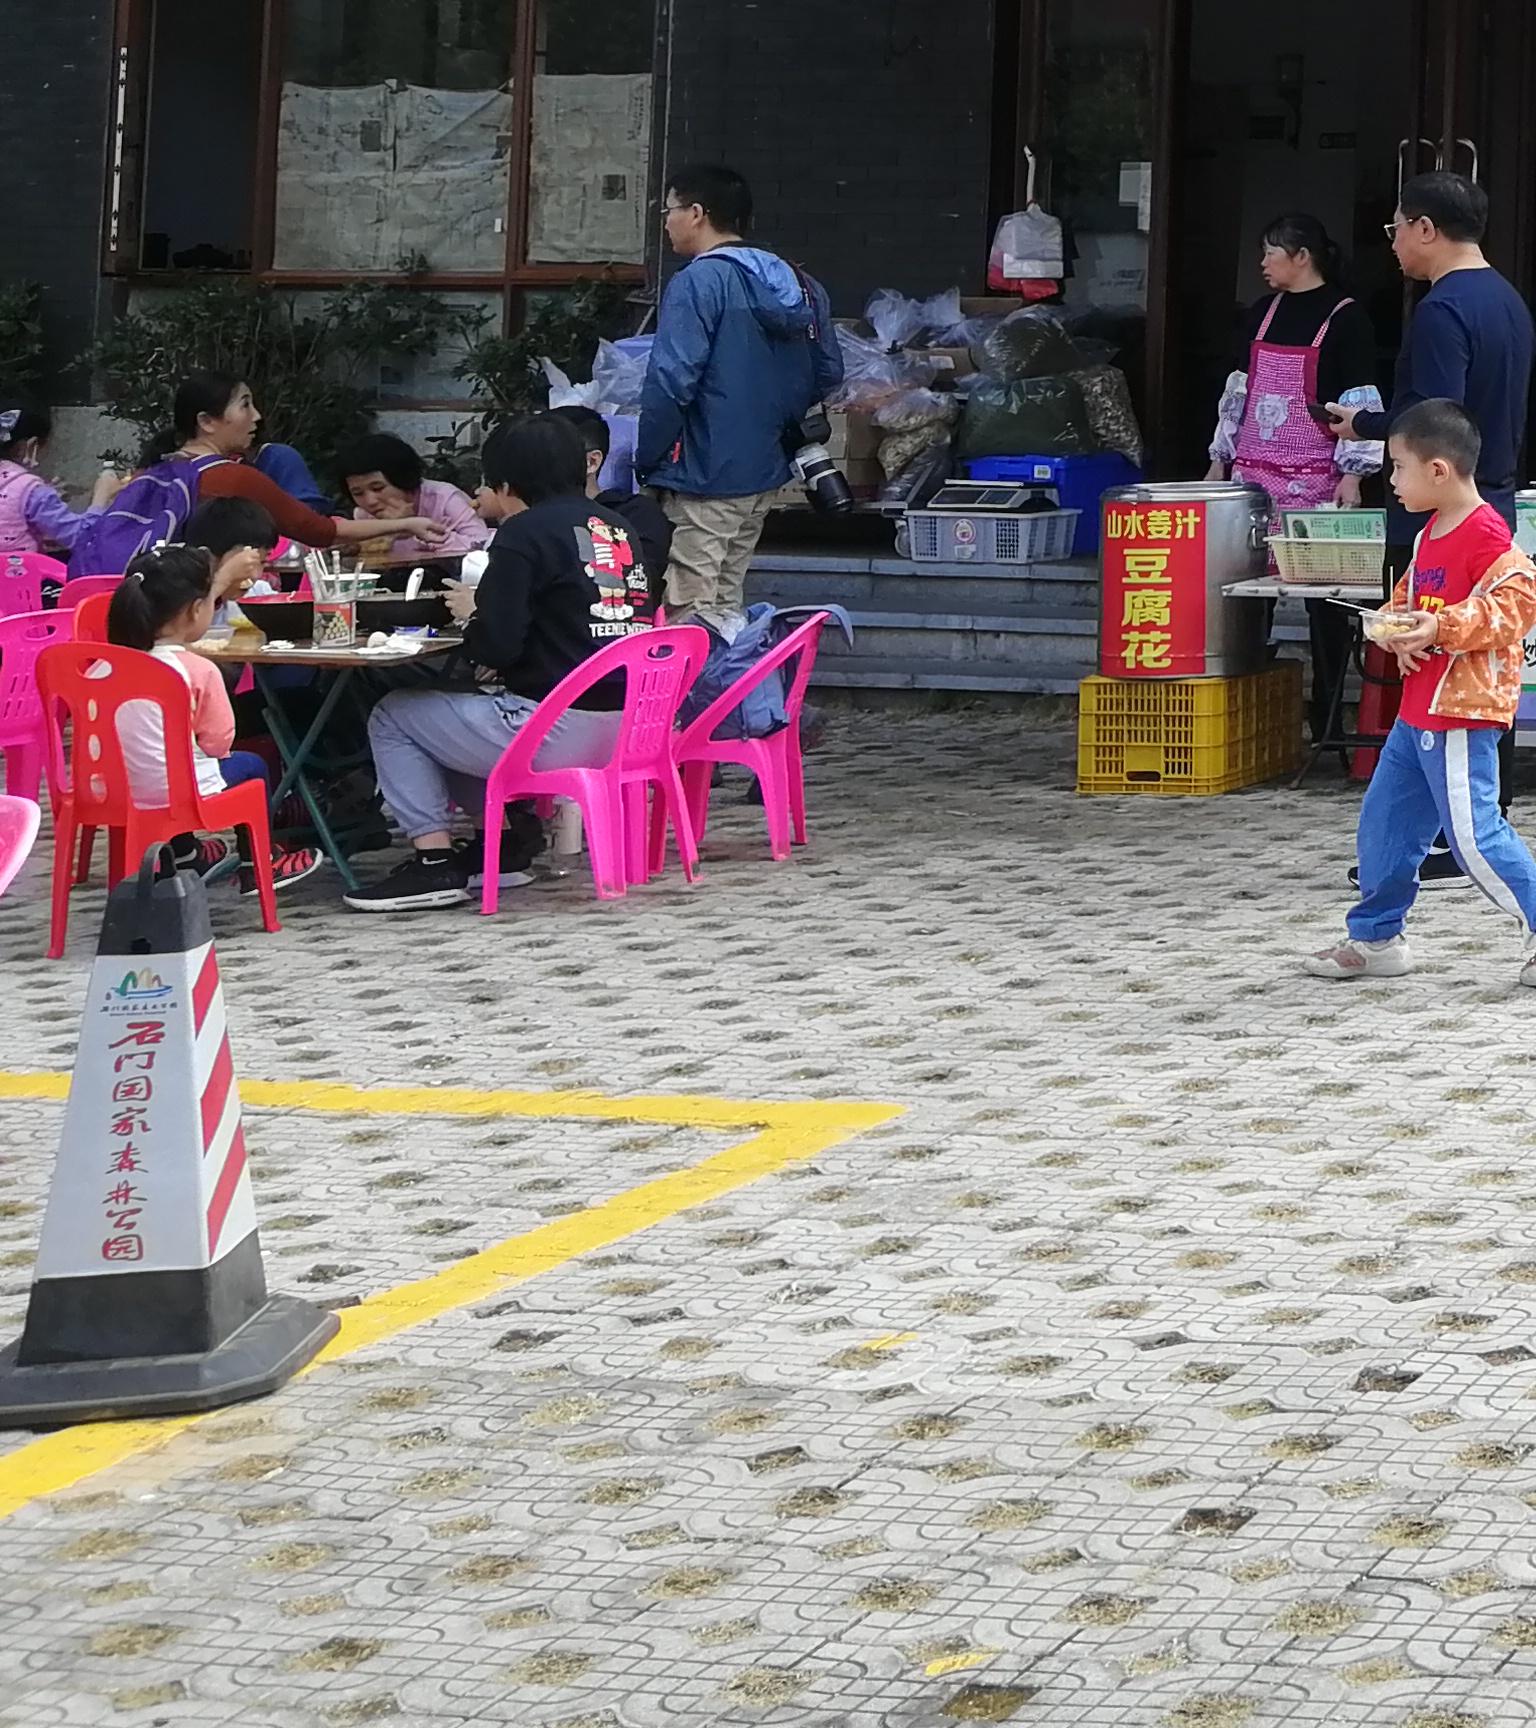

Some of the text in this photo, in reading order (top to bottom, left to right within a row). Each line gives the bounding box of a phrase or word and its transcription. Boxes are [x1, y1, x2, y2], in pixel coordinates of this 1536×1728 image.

[1107, 508, 1201, 540] 山水姜汁
[1121, 548, 1172, 669] 豆腐花
[102, 1021, 166, 1262] 石门国家森林公园
